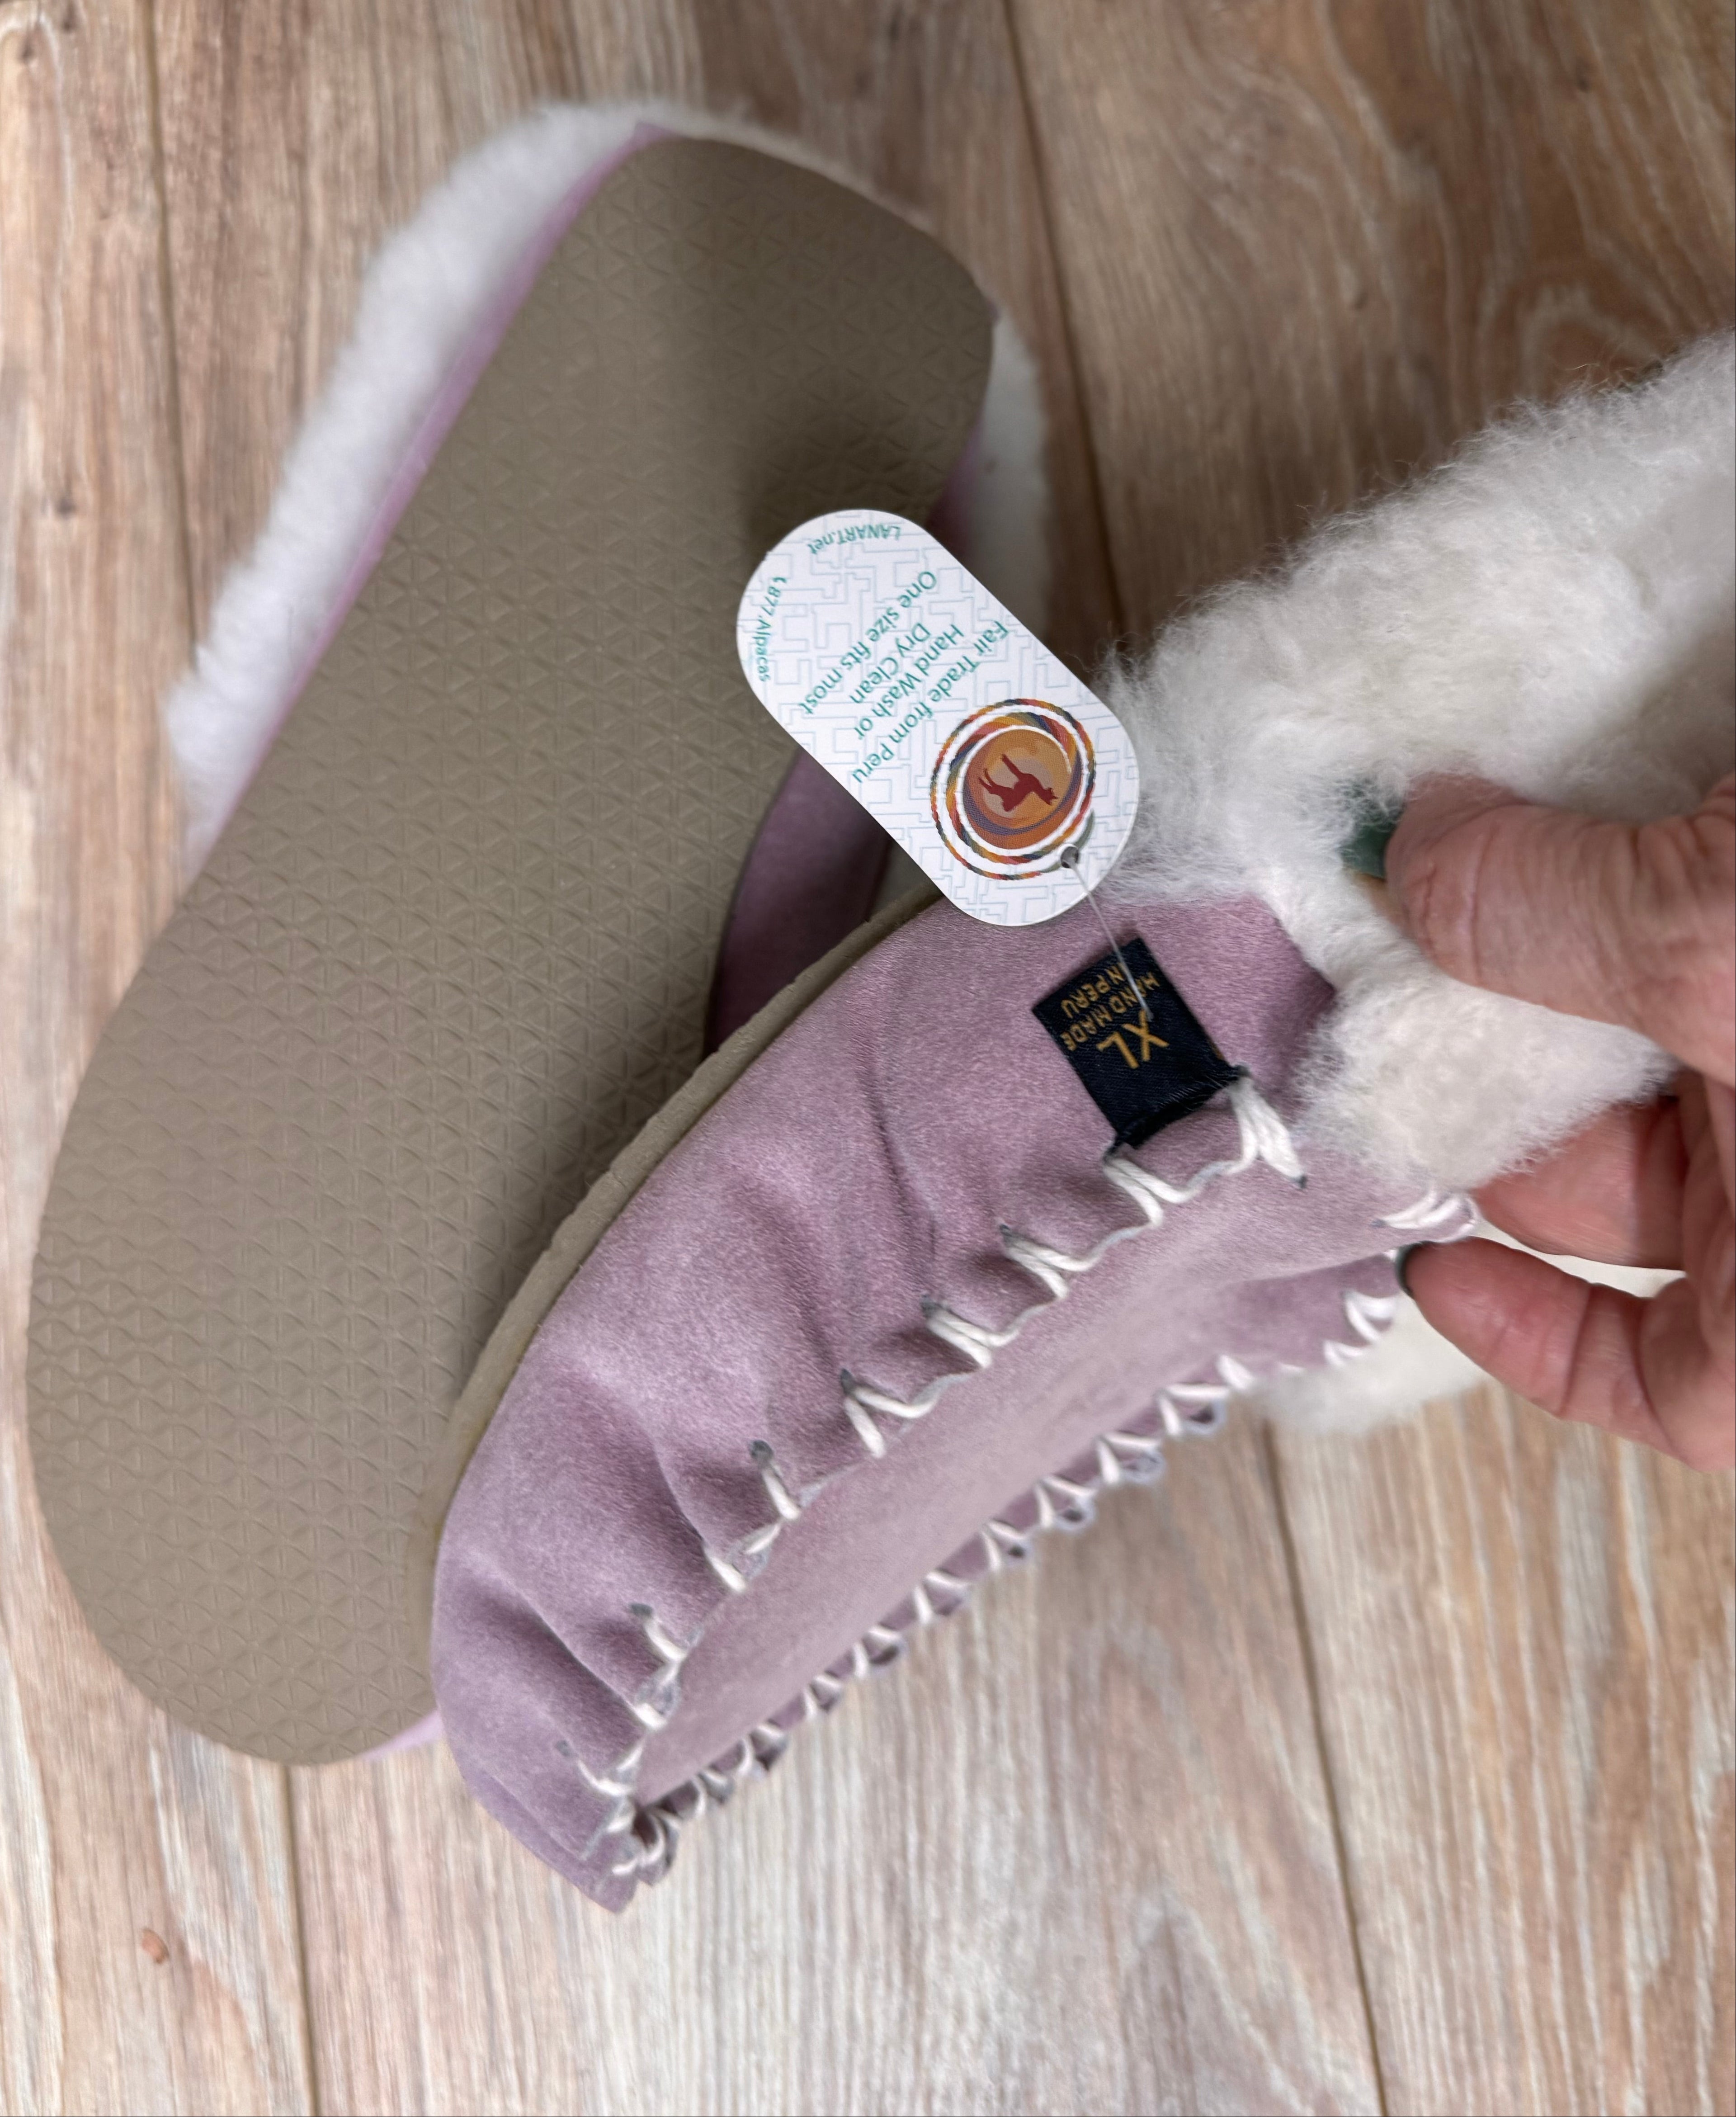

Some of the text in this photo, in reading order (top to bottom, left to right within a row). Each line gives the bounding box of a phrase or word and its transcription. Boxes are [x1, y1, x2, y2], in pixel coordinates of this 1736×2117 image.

[807, 524, 901, 554] LANART.net
[799, 571, 937, 714] One size fits most
[850, 622, 932, 704] Dry Clean
[854, 624, 965, 740] Hand Wash or
[851, 621, 1010, 783] Fair Trade from Peru
[1061, 974, 1110, 1018] PERU
[1096, 1009, 1169, 1068] XL
